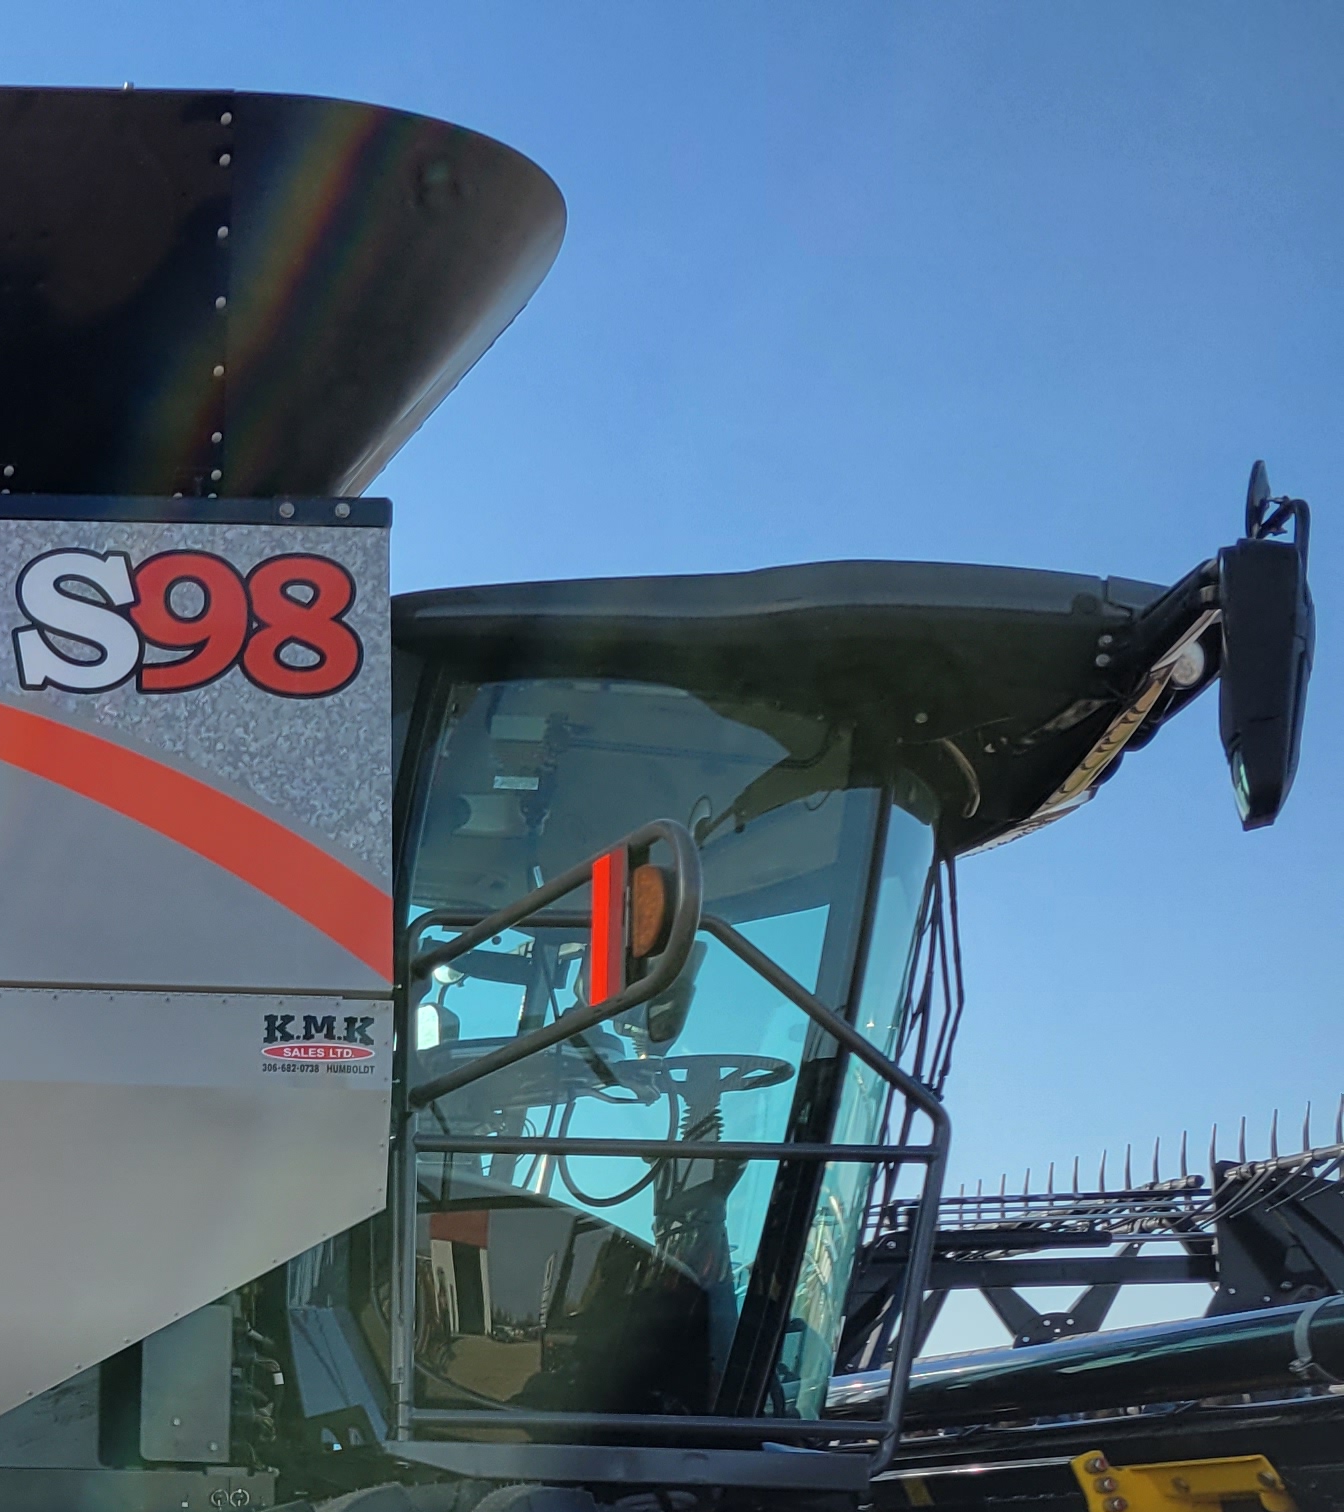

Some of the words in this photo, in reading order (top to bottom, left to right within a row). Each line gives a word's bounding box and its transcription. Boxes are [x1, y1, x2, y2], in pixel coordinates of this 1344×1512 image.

[12, 548, 364, 699] S98
[283, 1048, 325, 1058] SALES
[329, 1049, 355, 1058] LTD.
[326, 1064, 376, 1074] HUMBOLDT
